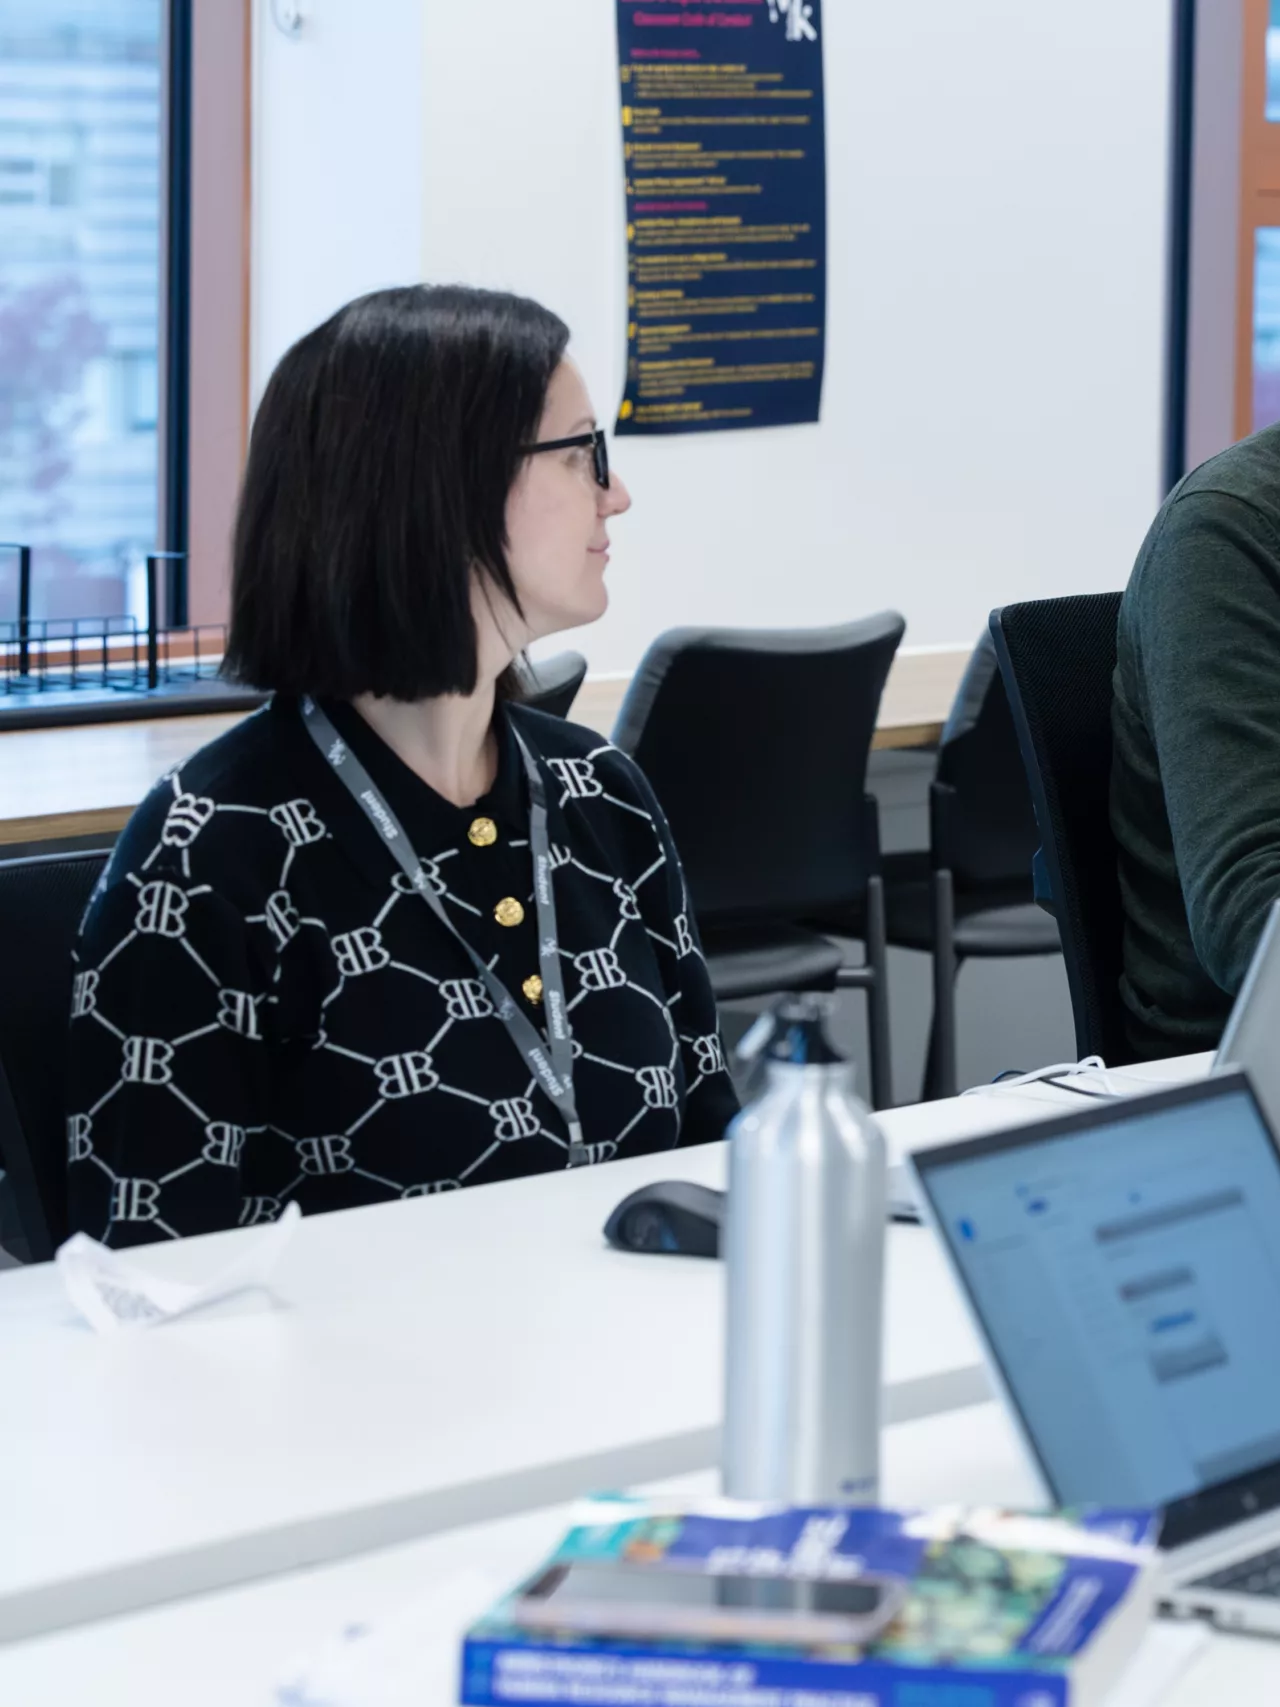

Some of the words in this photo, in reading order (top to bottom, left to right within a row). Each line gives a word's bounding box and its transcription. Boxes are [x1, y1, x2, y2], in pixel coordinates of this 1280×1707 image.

[361, 789, 399, 840] Student
[537, 854, 549, 905] Student
[548, 989, 566, 1041] Student
[528, 1047, 564, 1097] Student
